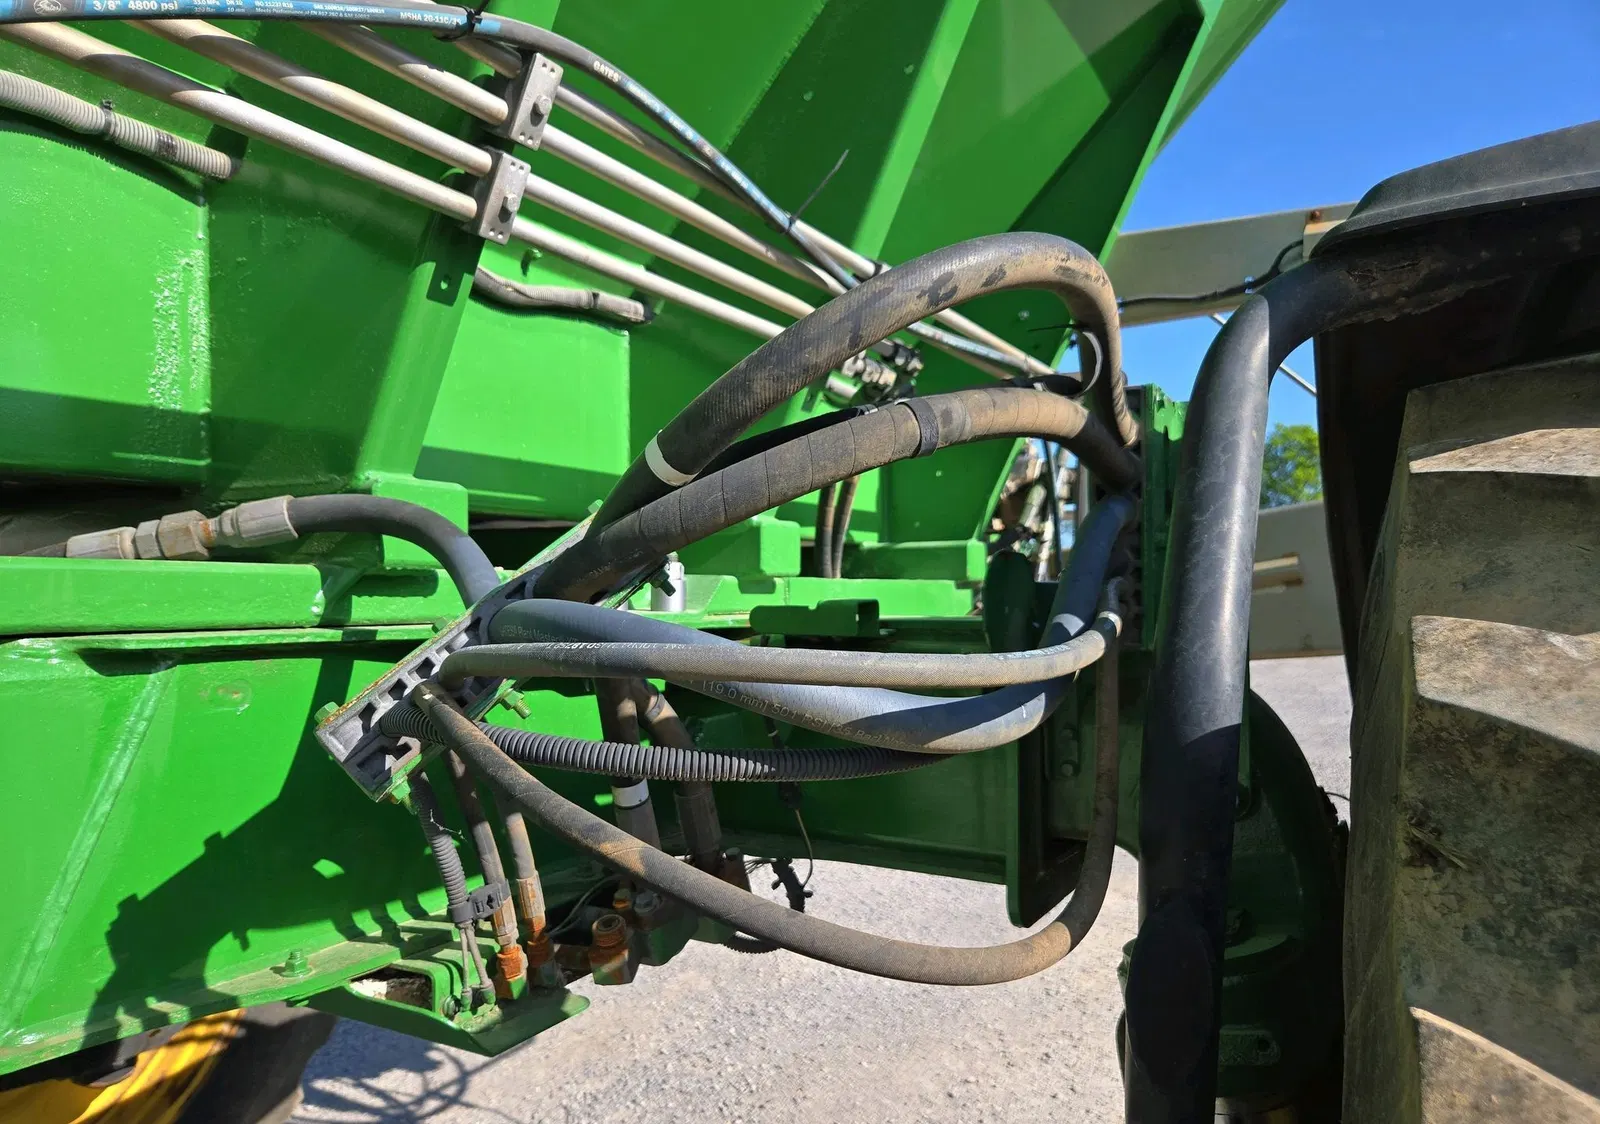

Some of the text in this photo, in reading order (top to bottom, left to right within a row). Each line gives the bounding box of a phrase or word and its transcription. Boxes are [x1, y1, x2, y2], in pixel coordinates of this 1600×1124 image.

[93, 0, 178, 12] 3/8" 4800 psi
[400, 11, 422, 21] MSHA
[593, 60, 619, 83] GATES
[702, 680, 737, 699] [19.0
[740, 693, 768, 711] mm]
